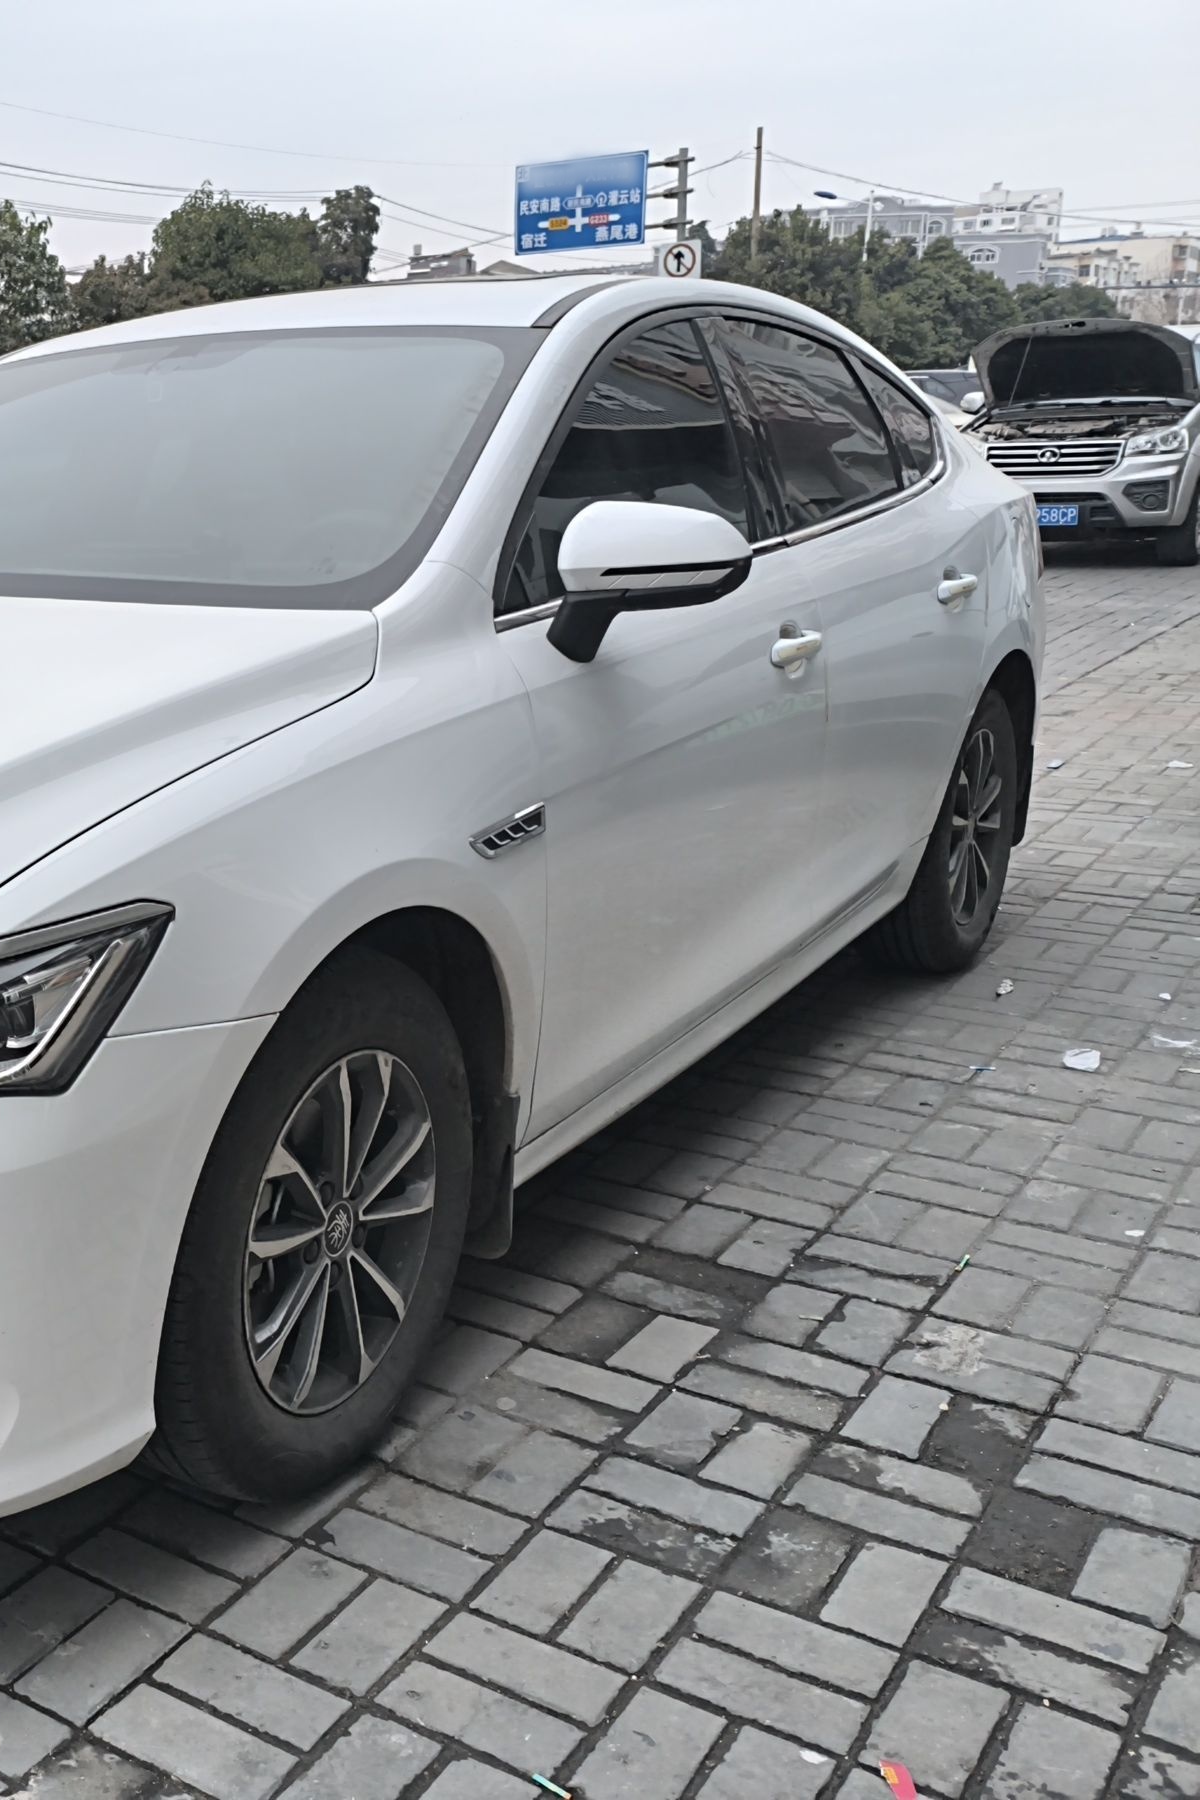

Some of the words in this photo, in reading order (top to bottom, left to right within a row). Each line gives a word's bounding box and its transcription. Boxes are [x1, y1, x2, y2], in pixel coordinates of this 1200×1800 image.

[519, 196, 560, 216] 民安南路
[607, 187, 640, 207] 灌云站
[521, 232, 547, 249] 宿迁
[595, 222, 639, 242] 燕尾港
